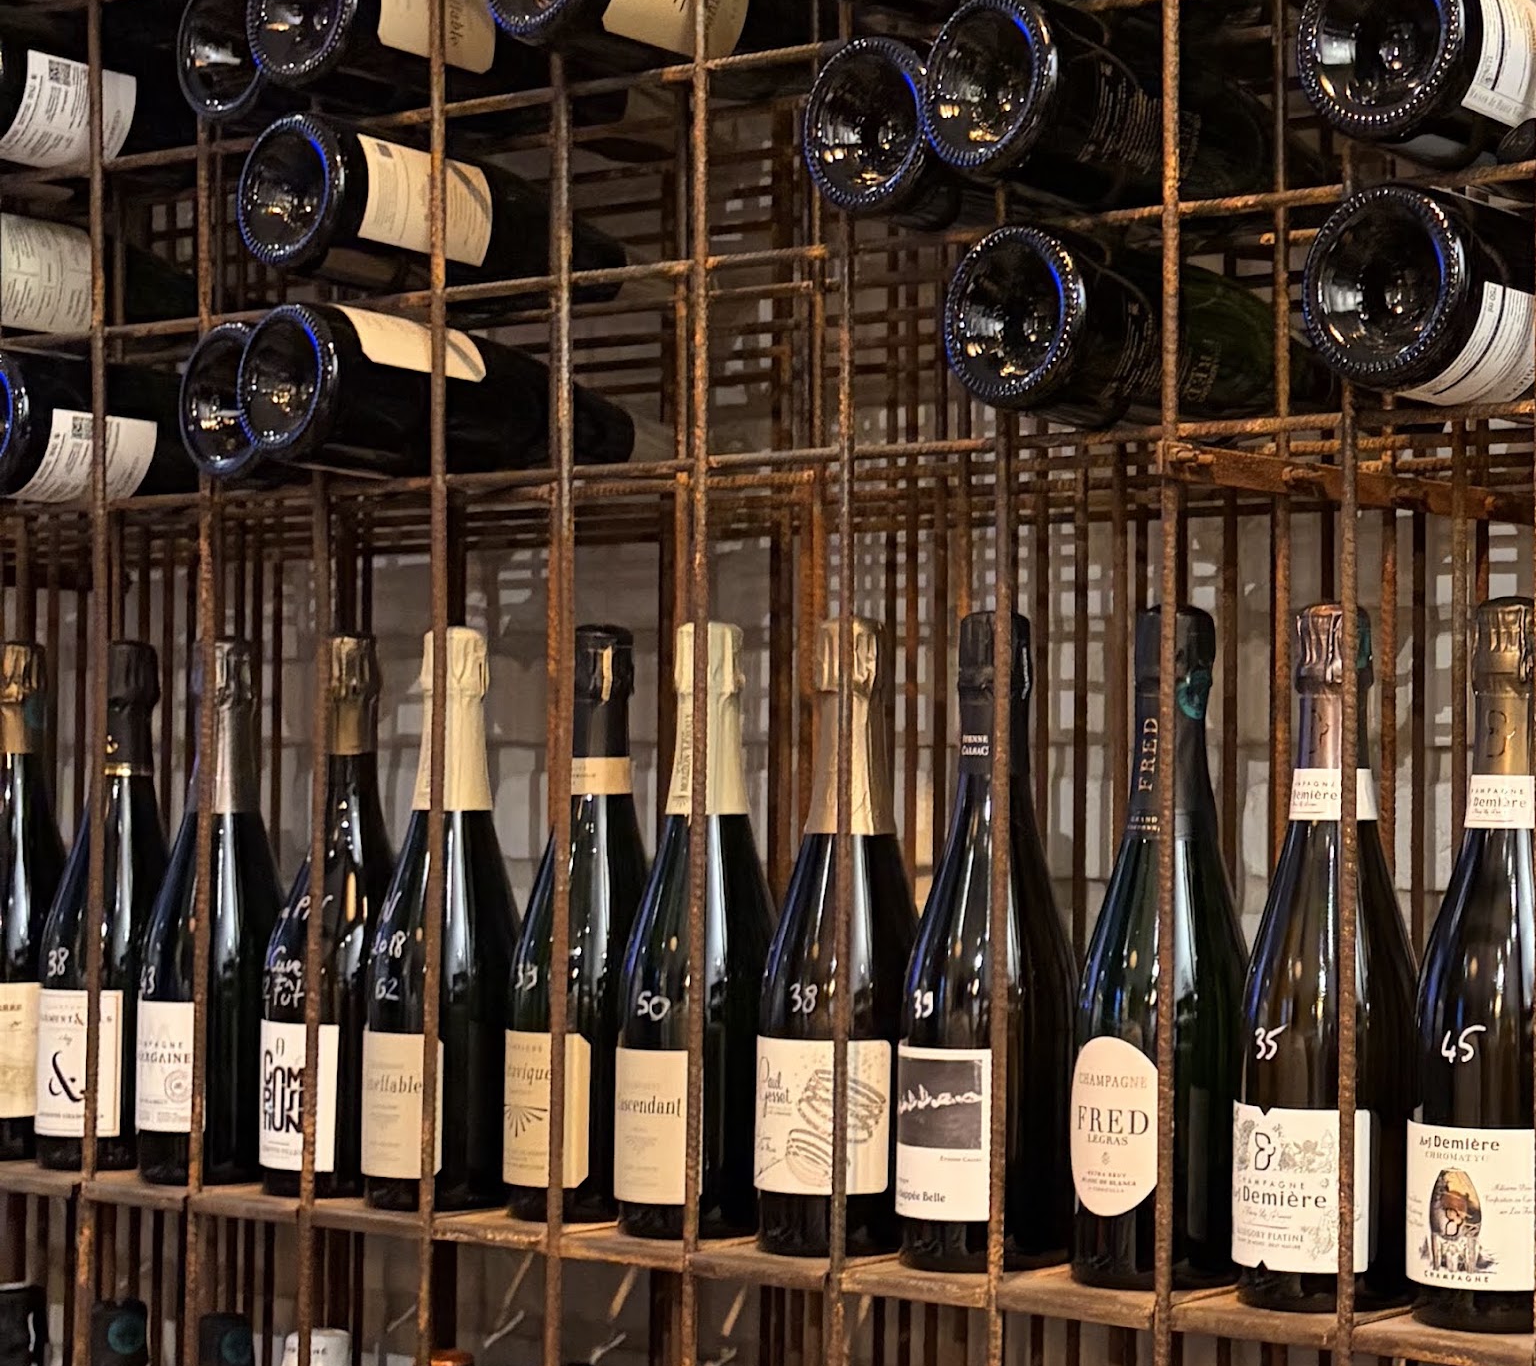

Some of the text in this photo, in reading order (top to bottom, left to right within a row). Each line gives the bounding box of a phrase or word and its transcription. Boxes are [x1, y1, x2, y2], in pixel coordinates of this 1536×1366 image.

[1138, 717, 1159, 793] FRED
[47, 947, 69, 978] 38
[637, 991, 671, 1021] 50
[789, 982, 818, 1014] 38
[913, 988, 934, 1020] 39
[1254, 1024, 1288, 1061] 35
[1440, 1024, 1487, 1064] 45
[1078, 1071, 1148, 1089] CHAMPAGNE
[1077, 1104, 1150, 1136] FRED
[1087, 1134, 1129, 1147] LEGRAS
[1434, 1135, 1501, 1153] Demière
[922, 1191, 947, 1204] Belle
[1242, 1185, 1327, 1209] Demière
[1424, 1269, 1490, 1284] CHAMPAGNE
